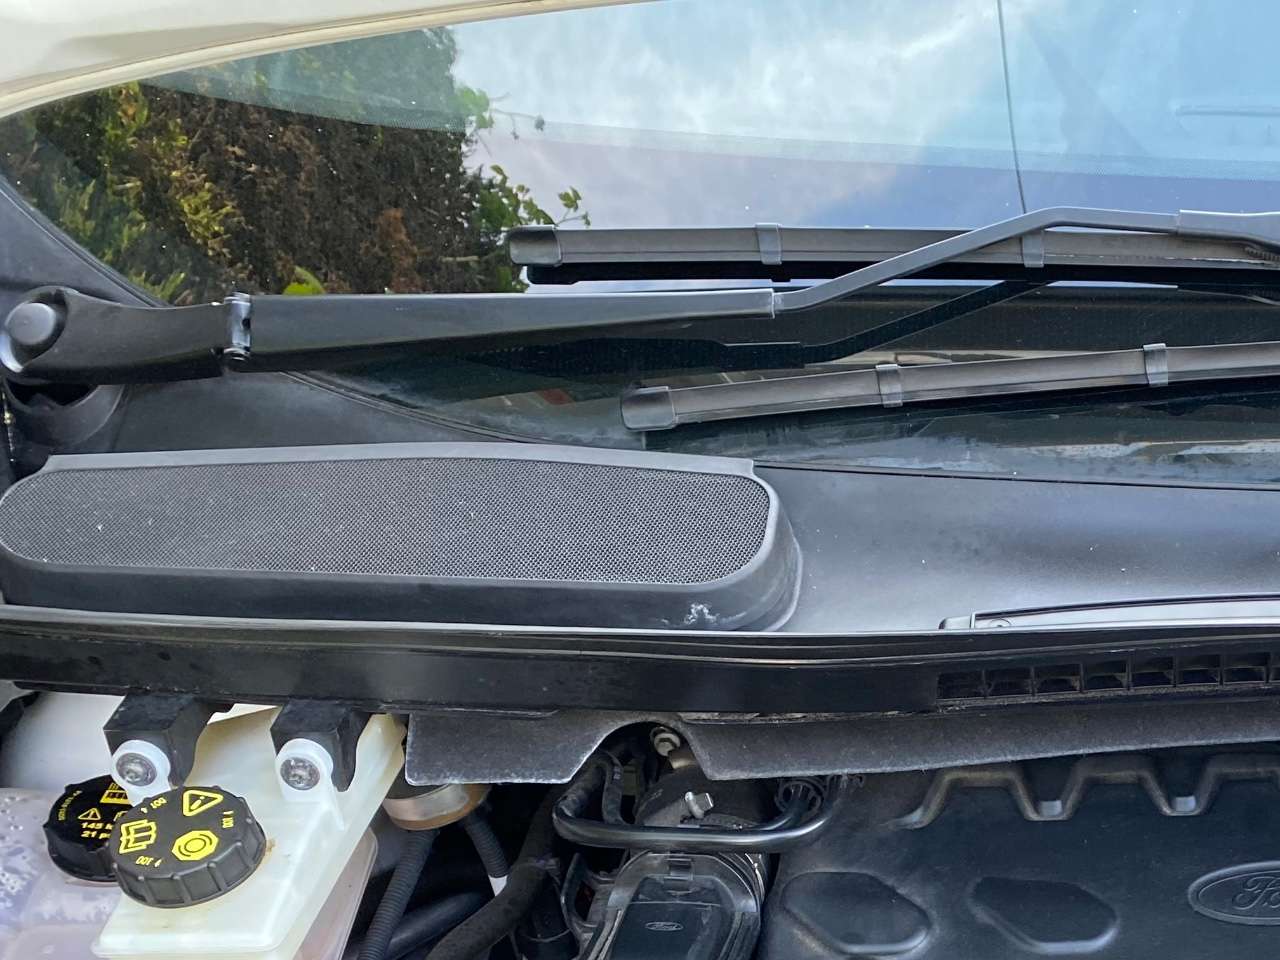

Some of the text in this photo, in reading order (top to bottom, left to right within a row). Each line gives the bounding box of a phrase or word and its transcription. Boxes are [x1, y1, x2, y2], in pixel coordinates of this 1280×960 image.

[80, 821, 104, 830] 145
[80, 830, 98, 839] 21
[135, 855, 155, 867] DOT
